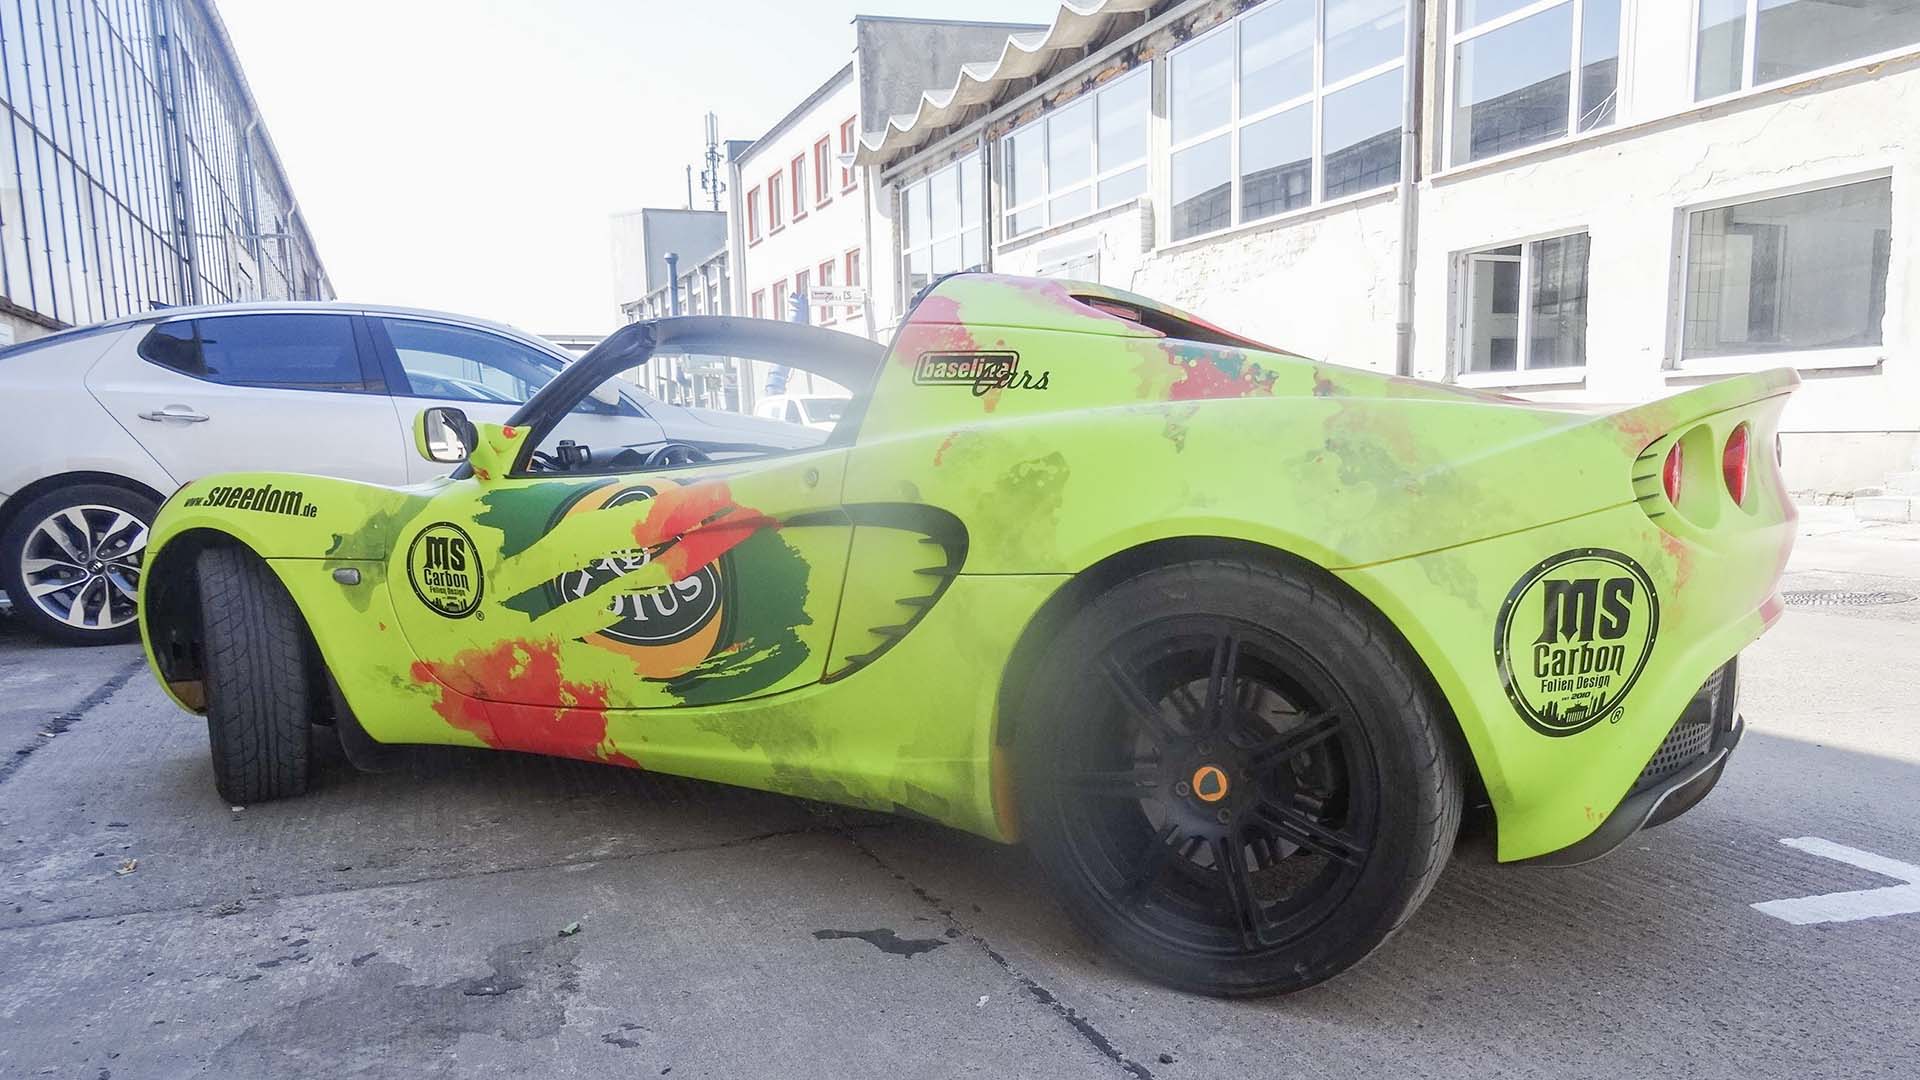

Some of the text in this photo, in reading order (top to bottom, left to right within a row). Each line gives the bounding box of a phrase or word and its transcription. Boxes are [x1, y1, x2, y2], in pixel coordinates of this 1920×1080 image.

[921, 355, 1050, 397] baseline Cars
[423, 536, 466, 572] MS
[424, 569, 470, 592] Carbon
[1531, 577, 1635, 646] MS
[1534, 642, 1626, 678] Carbon
[1541, 675, 1611, 694] Folien Design
[1571, 691, 1592, 700] 2010
